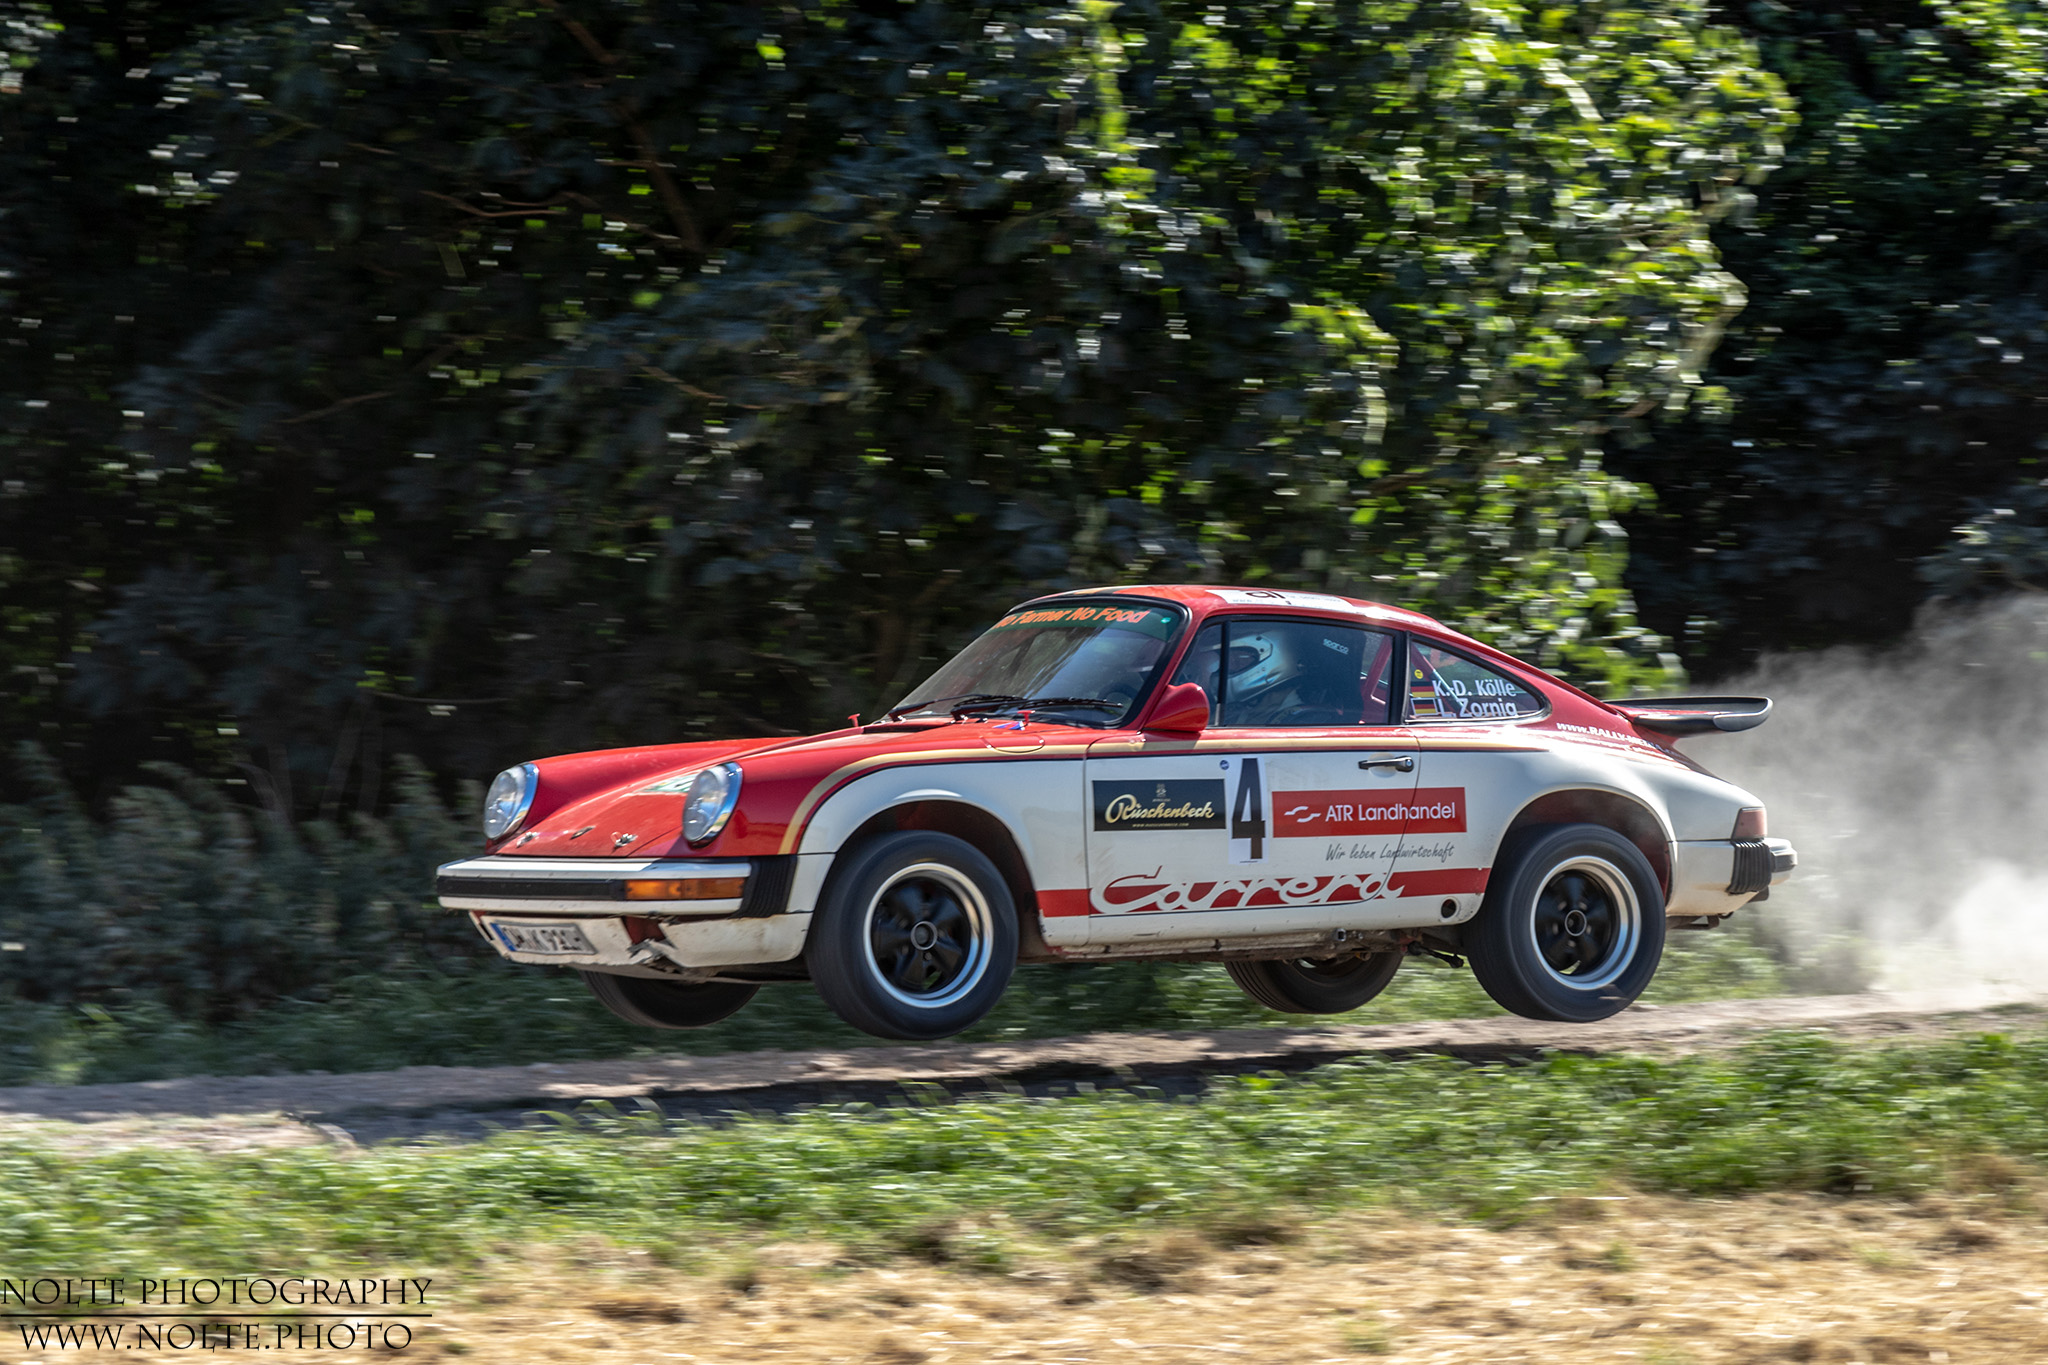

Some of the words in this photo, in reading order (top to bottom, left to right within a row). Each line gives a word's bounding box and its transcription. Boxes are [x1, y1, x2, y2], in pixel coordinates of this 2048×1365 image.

[1012, 610, 1072, 625] Farmer
[1066, 606, 1095, 621] No
[1093, 607, 1151, 624] Food
[1475, 679, 1518, 697] Kölle
[1105, 794, 1215, 824] Rüschenbeck
[1232, 758, 1266, 859] 4
[1325, 804, 1353, 823] ATR
[1357, 801, 1456, 821] Landhandel
[1325, 843, 1346, 861] Wir
[1349, 843, 1376, 860] leben
[1379, 841, 1455, 864] Landwirtschaft
[1088, 865, 1406, 915] Carrera
